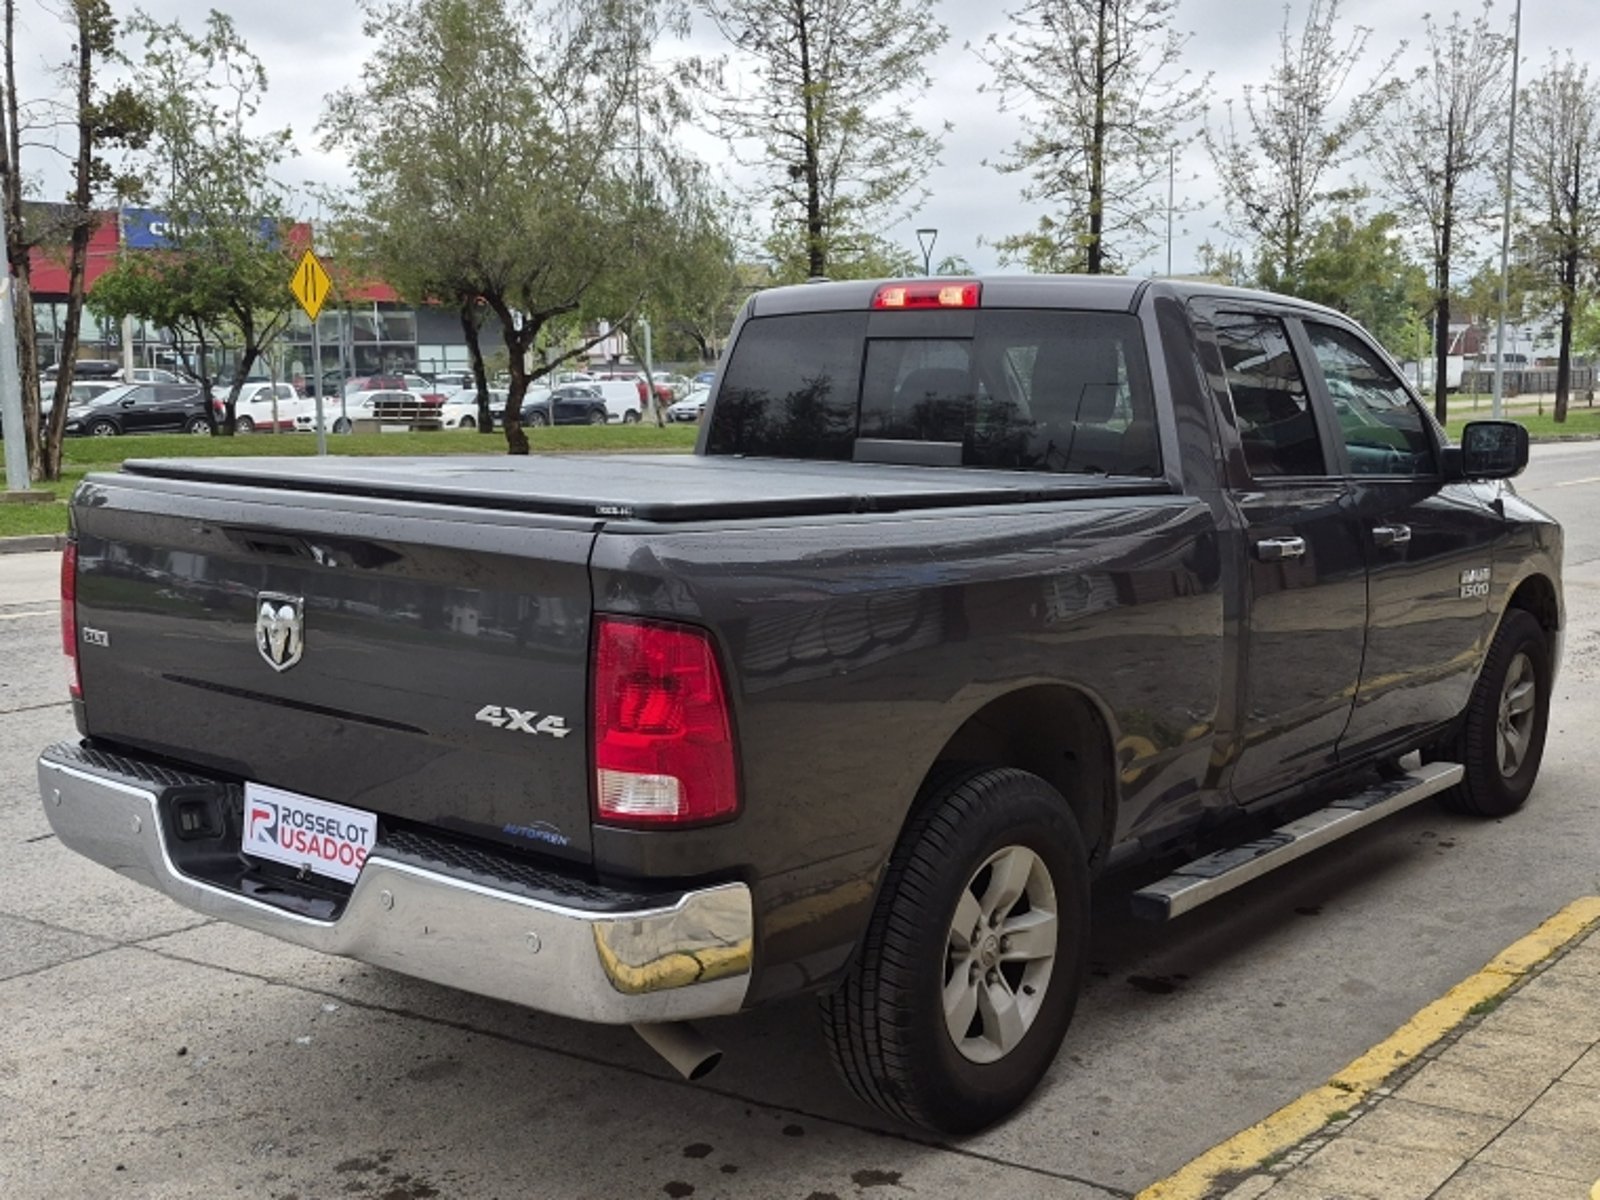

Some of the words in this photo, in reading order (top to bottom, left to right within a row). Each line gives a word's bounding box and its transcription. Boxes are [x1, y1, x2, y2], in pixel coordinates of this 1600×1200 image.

[1460, 582, 1490, 598] 1500
[281, 806, 369, 845] ROSSELOT
[280, 825, 367, 870] USADOS
